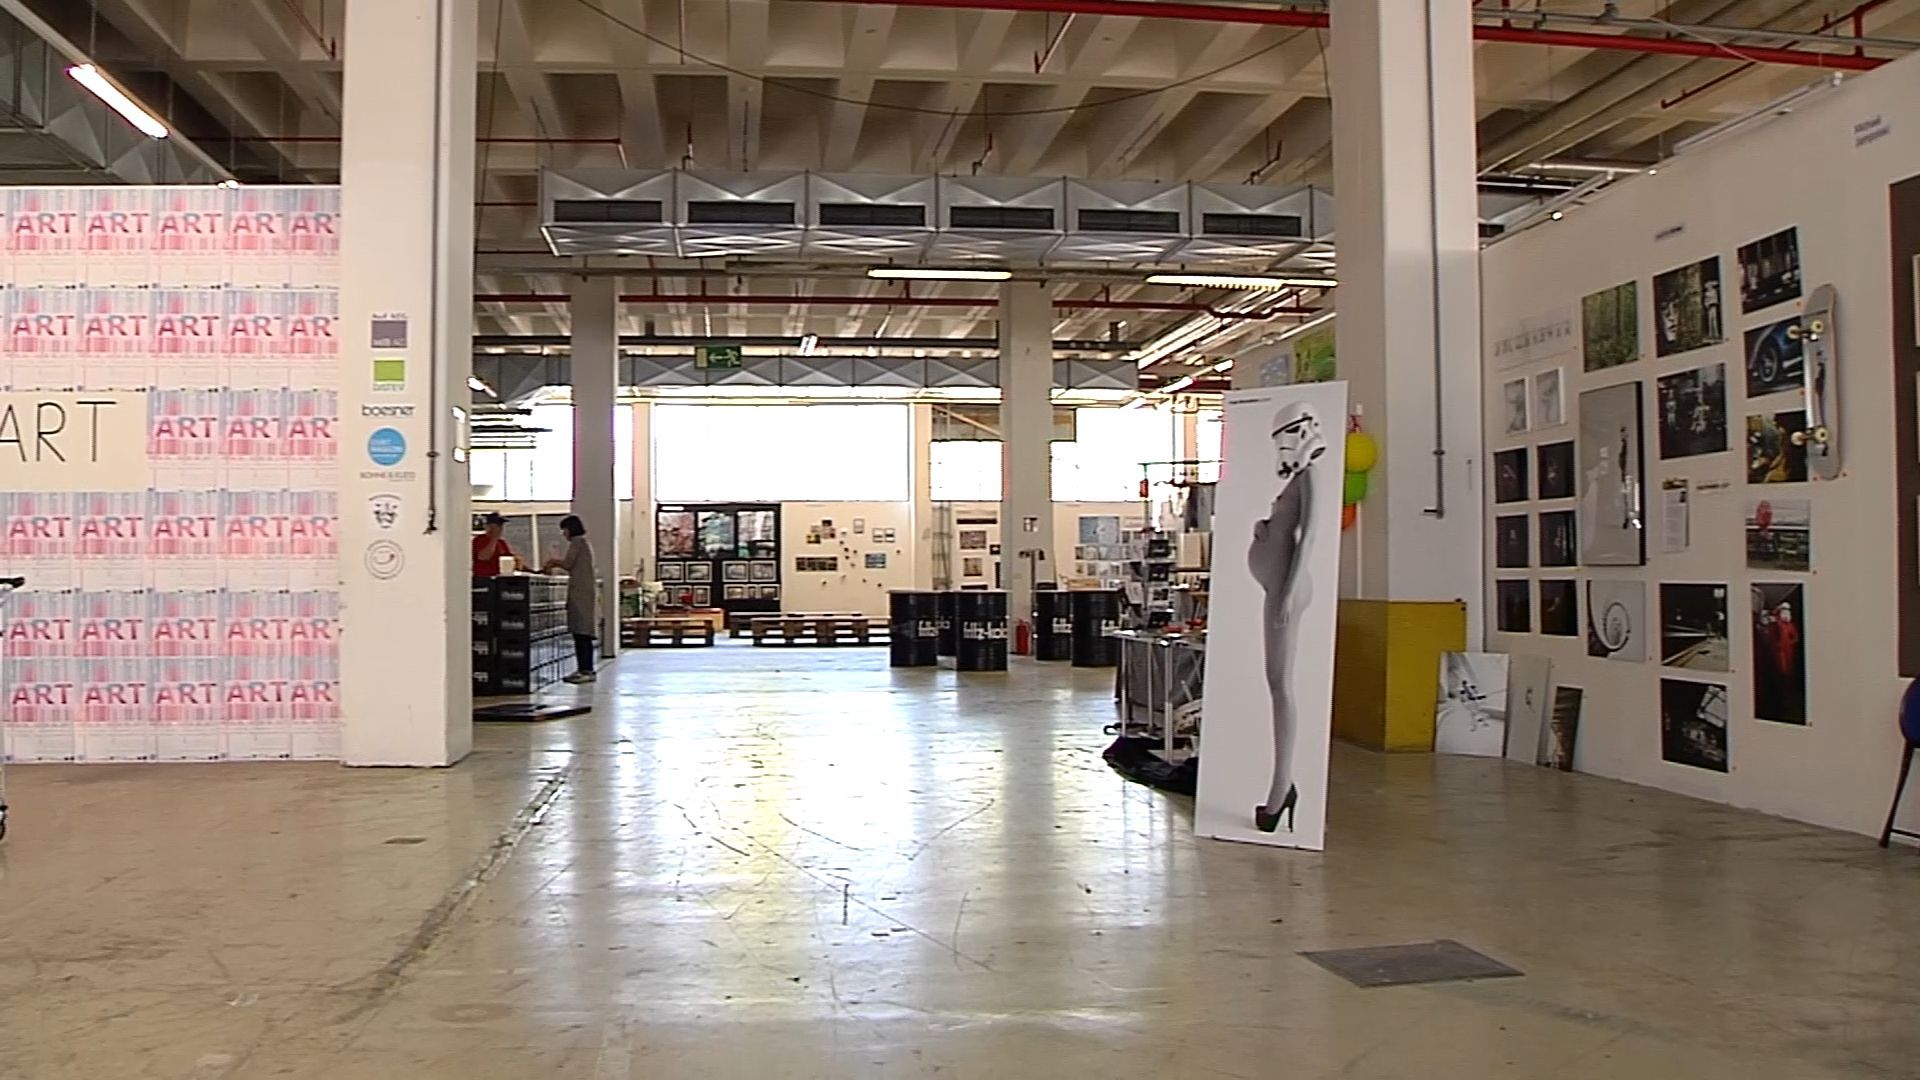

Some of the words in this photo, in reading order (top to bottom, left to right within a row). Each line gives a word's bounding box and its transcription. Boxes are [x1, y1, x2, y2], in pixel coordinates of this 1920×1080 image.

[15, 213, 76, 234] ART
[88, 213, 149, 234] ART
[160, 213, 222, 234] ART
[291, 213, 341, 234] AR
[13, 315, 74, 337] ART
[85, 315, 147, 337] ART
[157, 315, 220, 337] ART
[290, 315, 339, 337] AR
[361, 404, 415, 416] boesner
[0, 400, 117, 462] ART
[155, 417, 218, 438] ART
[288, 417, 339, 438] AR
[9, 517, 70, 538] ART
[81, 517, 143, 538] ART
[154, 517, 216, 538] ART
[226, 517, 289, 538] ART
[290, 517, 338, 538] AR
[10, 619, 71, 640] ART
[82, 619, 143, 640] ART
[154, 619, 216, 640] ART
[227, 619, 289, 640] ART
[290, 619, 339, 640] AR
[12, 684, 73, 704] ART
[84, 683, 145, 704] ART
[156, 683, 217, 704] ART
[226, 681, 287, 703] ART
[290, 681, 339, 703] AR
